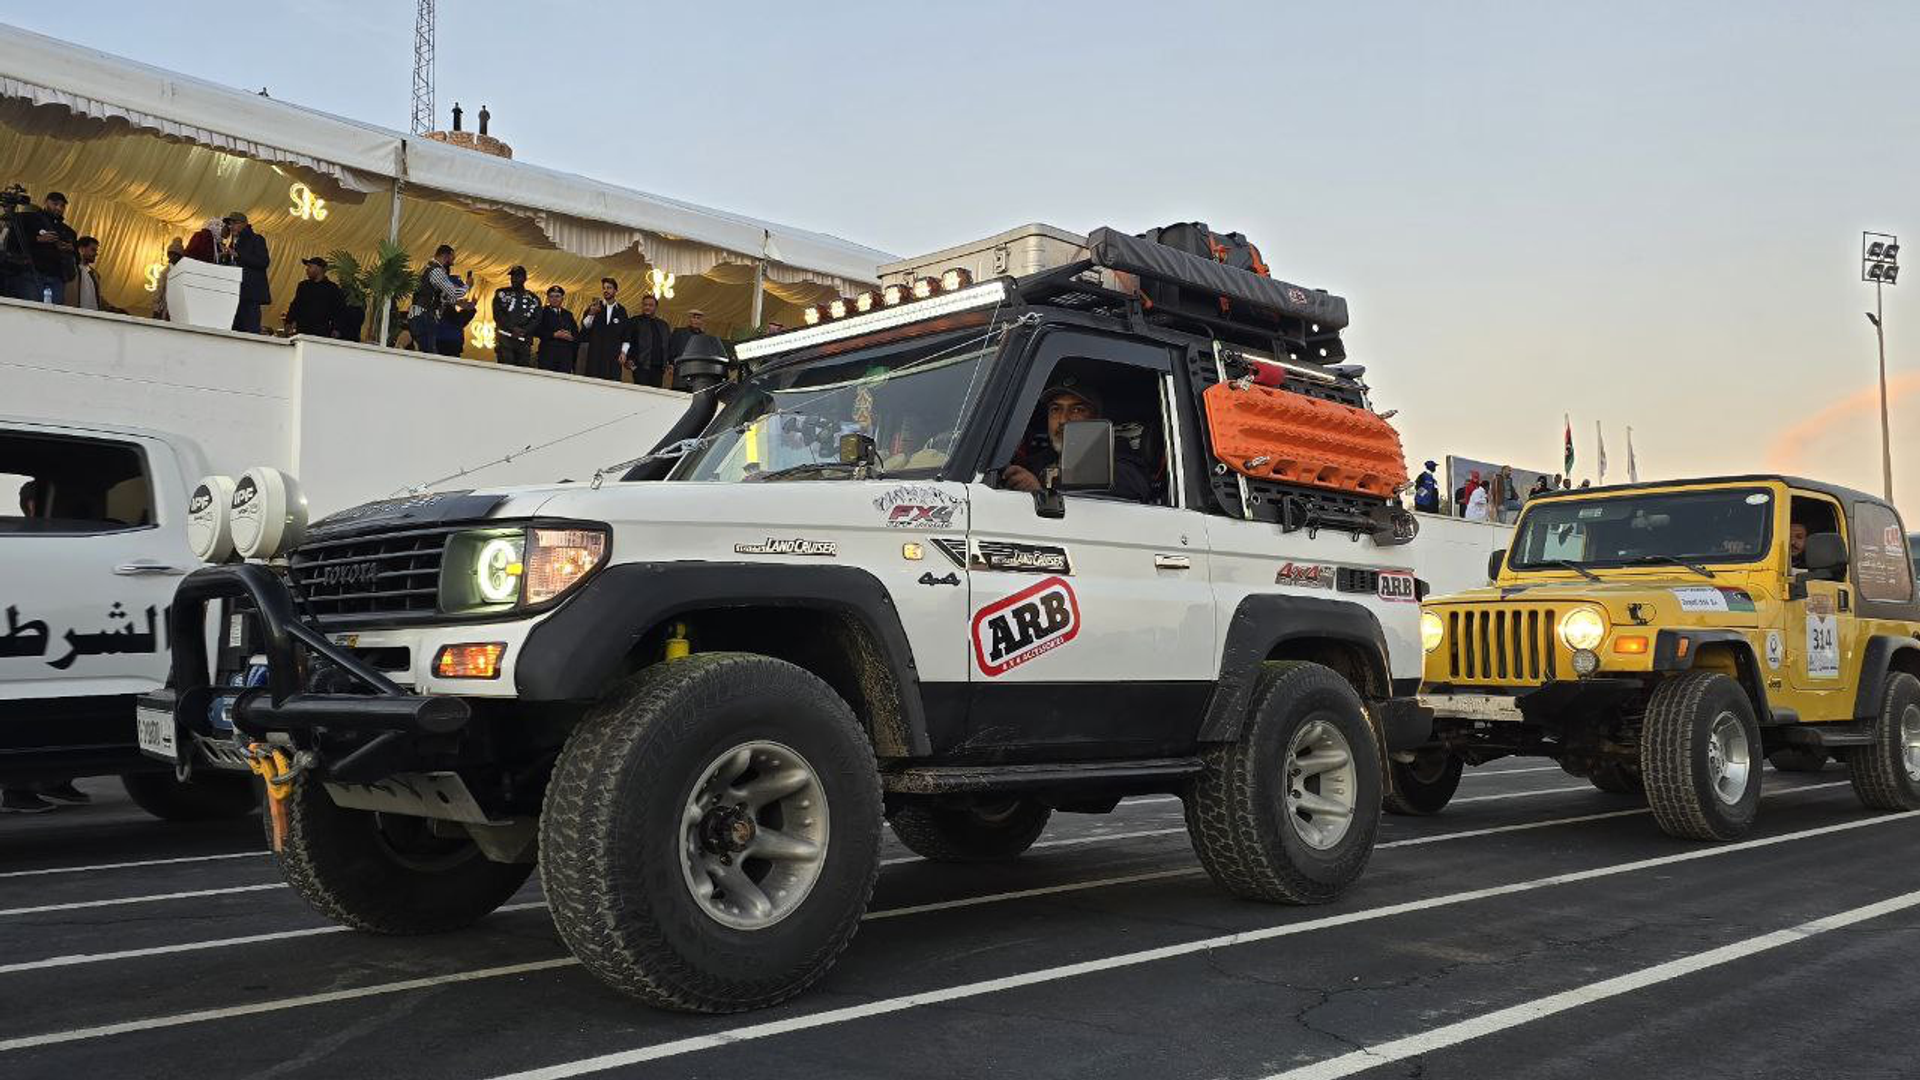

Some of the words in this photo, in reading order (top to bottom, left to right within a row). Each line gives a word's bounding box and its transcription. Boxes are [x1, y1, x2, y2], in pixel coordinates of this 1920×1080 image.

[889, 505, 954, 521] FX4
[322, 563, 377, 586] TOYOTA
[1381, 576, 1412, 597] ARB
[0, 601, 172, 670] الشرط
[988, 591, 1070, 663] ARB
[1813, 629, 1833, 651] 314
